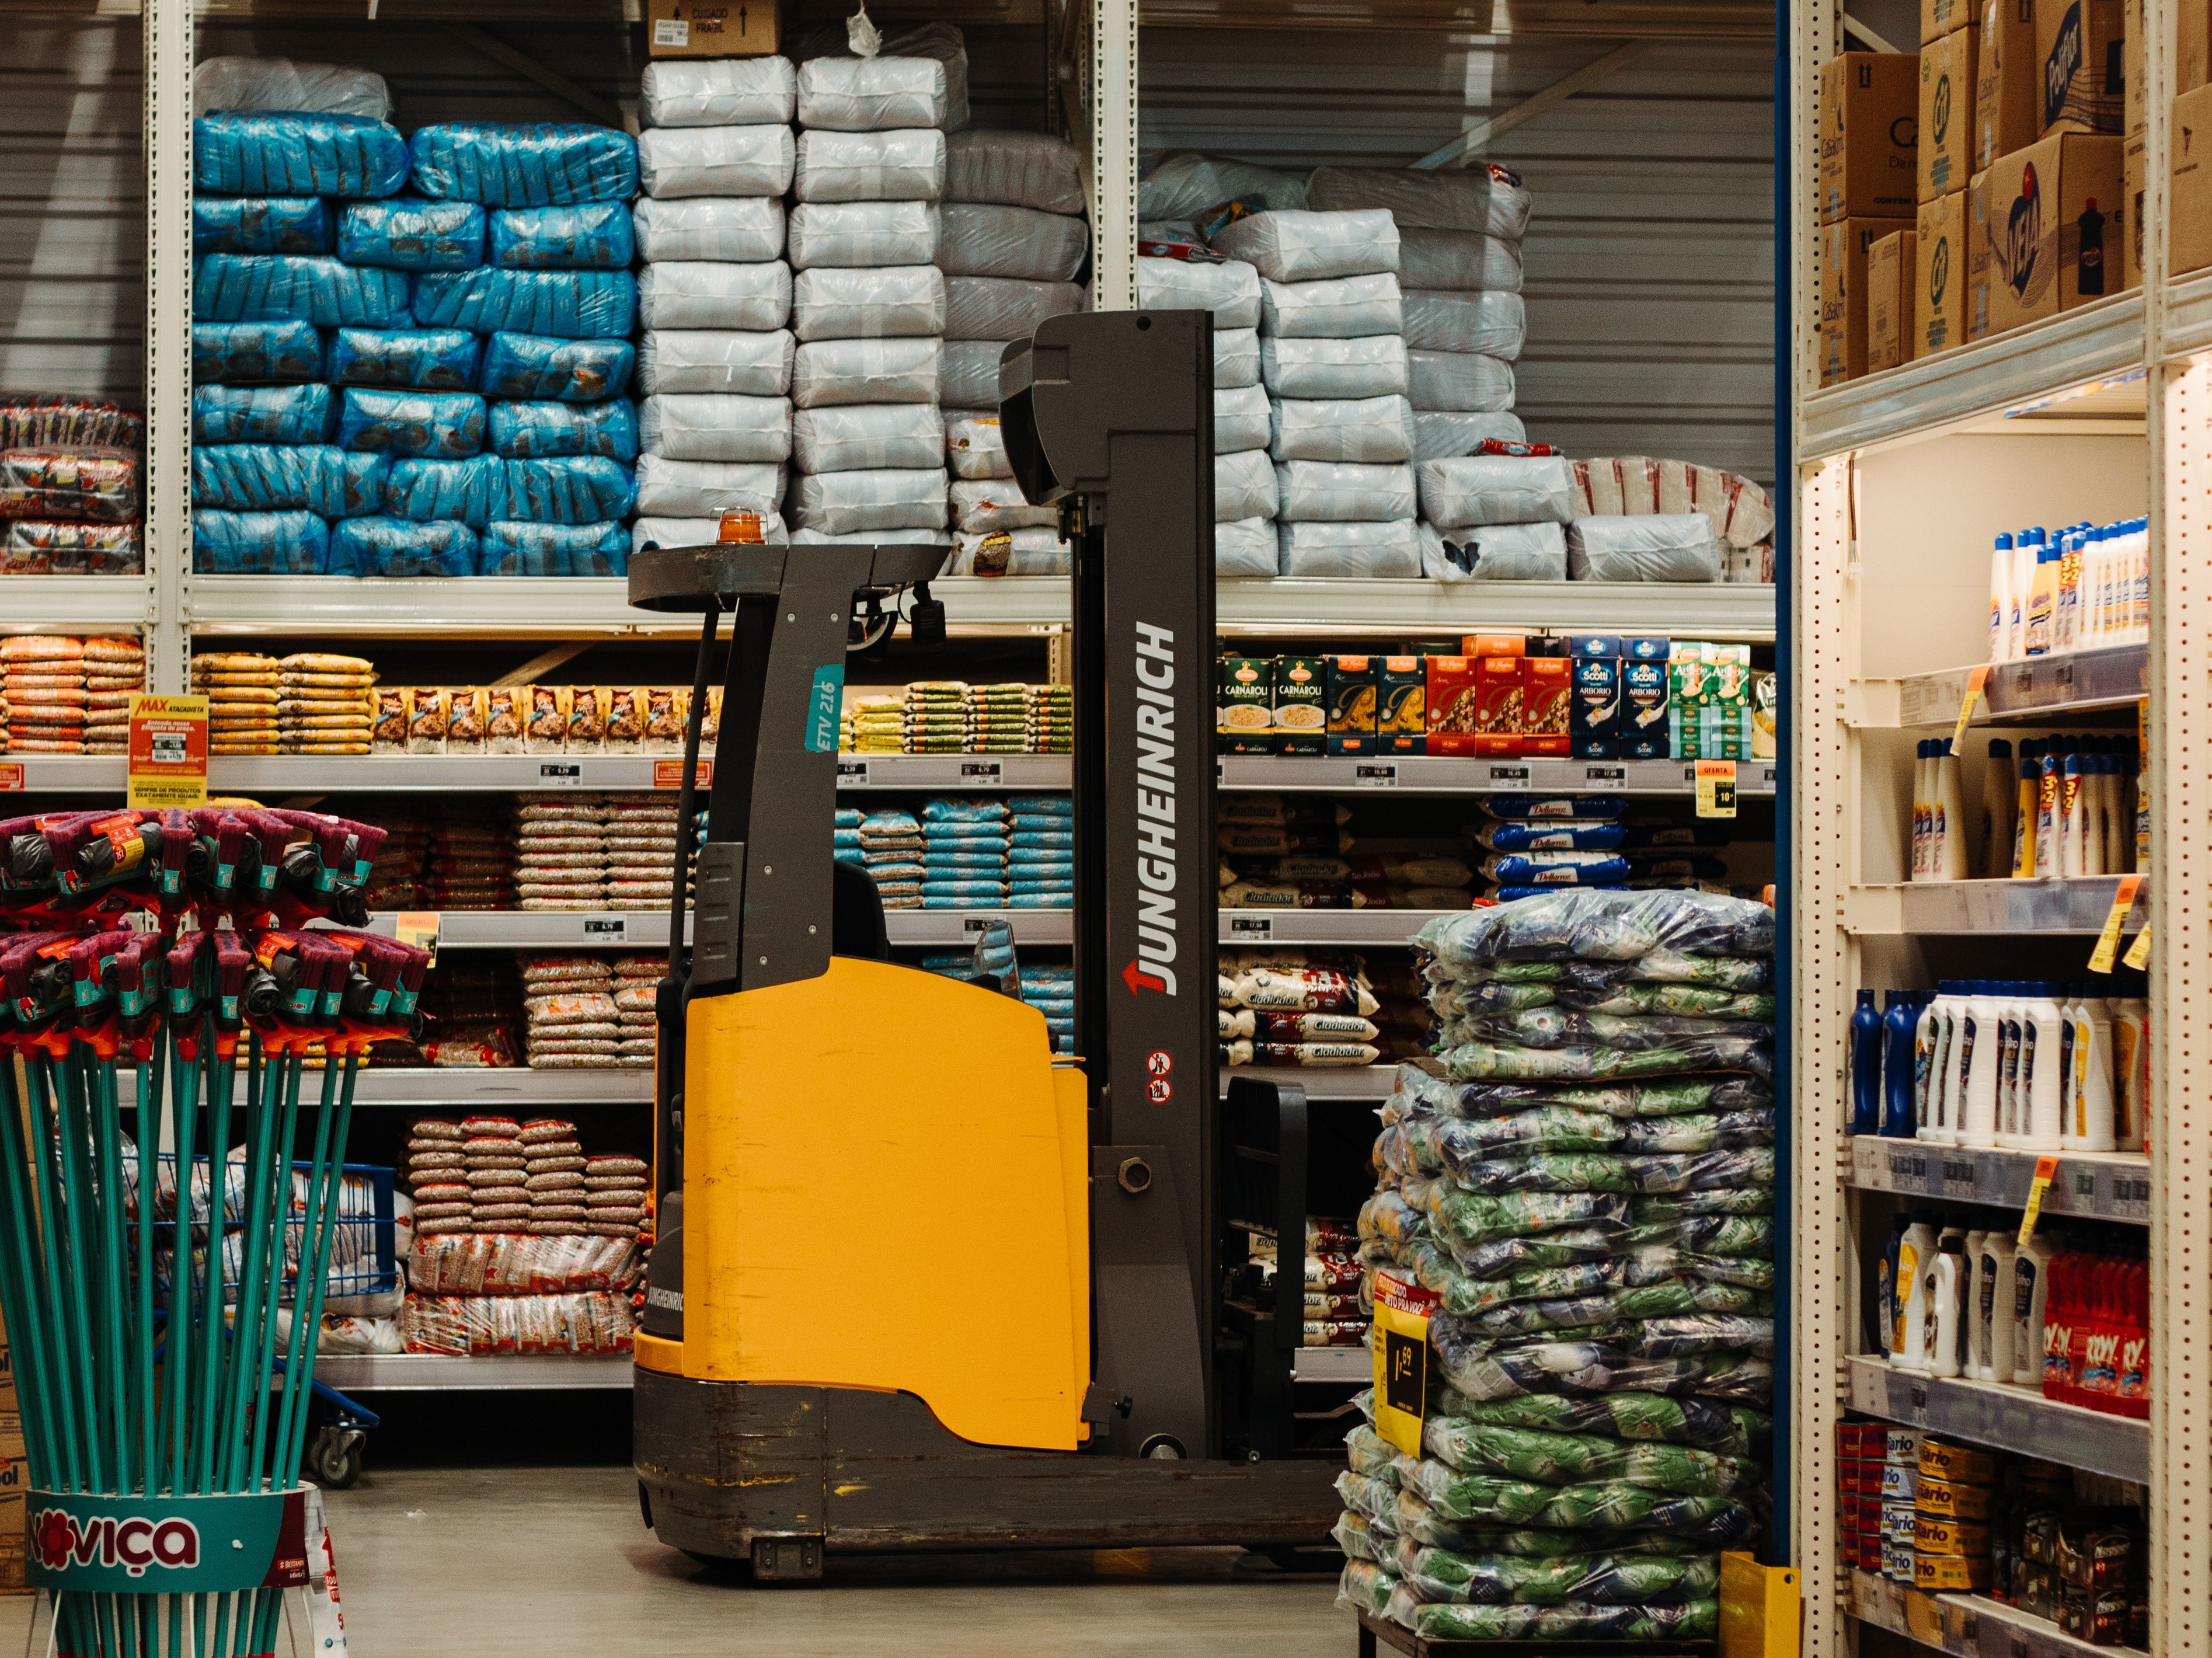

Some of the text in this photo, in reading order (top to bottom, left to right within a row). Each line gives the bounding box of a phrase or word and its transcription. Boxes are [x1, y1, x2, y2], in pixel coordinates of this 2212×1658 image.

[692, 8, 728, 19] CUIDADO
[2049, 22, 2078, 108] Poliflor
[1583, 670, 1608, 681] Scotti
[1632, 670, 1657, 682] Scotti
[1225, 685, 1268, 695] CARNAROLI
[1279, 685, 1322, 695] CARNAROLI
[134, 699, 168, 716] MAX
[817, 680, 835, 751] ETV 216
[2044, 775, 2055, 789] 3
[2065, 781, 2076, 795] 3
[1720, 792, 1730, 802] 10
[1135, 621, 1177, 996] JUNGHEINRICH
[1534, 837, 1567, 847] Dellarroz
[1538, 872, 1571, 881] Dellarroz
[1243, 891, 1294, 904] Gladiador
[1248, 994, 1298, 1006] Gladiador
[1314, 1020, 1366, 1032] Gladiador
[1312, 1047, 1364, 1057] Gladiador
[647, 1286, 684, 1312] JUNGHEINRIC
[1398, 1297, 1409, 1312] PRA
[1409, 1300, 1425, 1315] VOCÊ
[0, 1465, 18, 1486] ol
